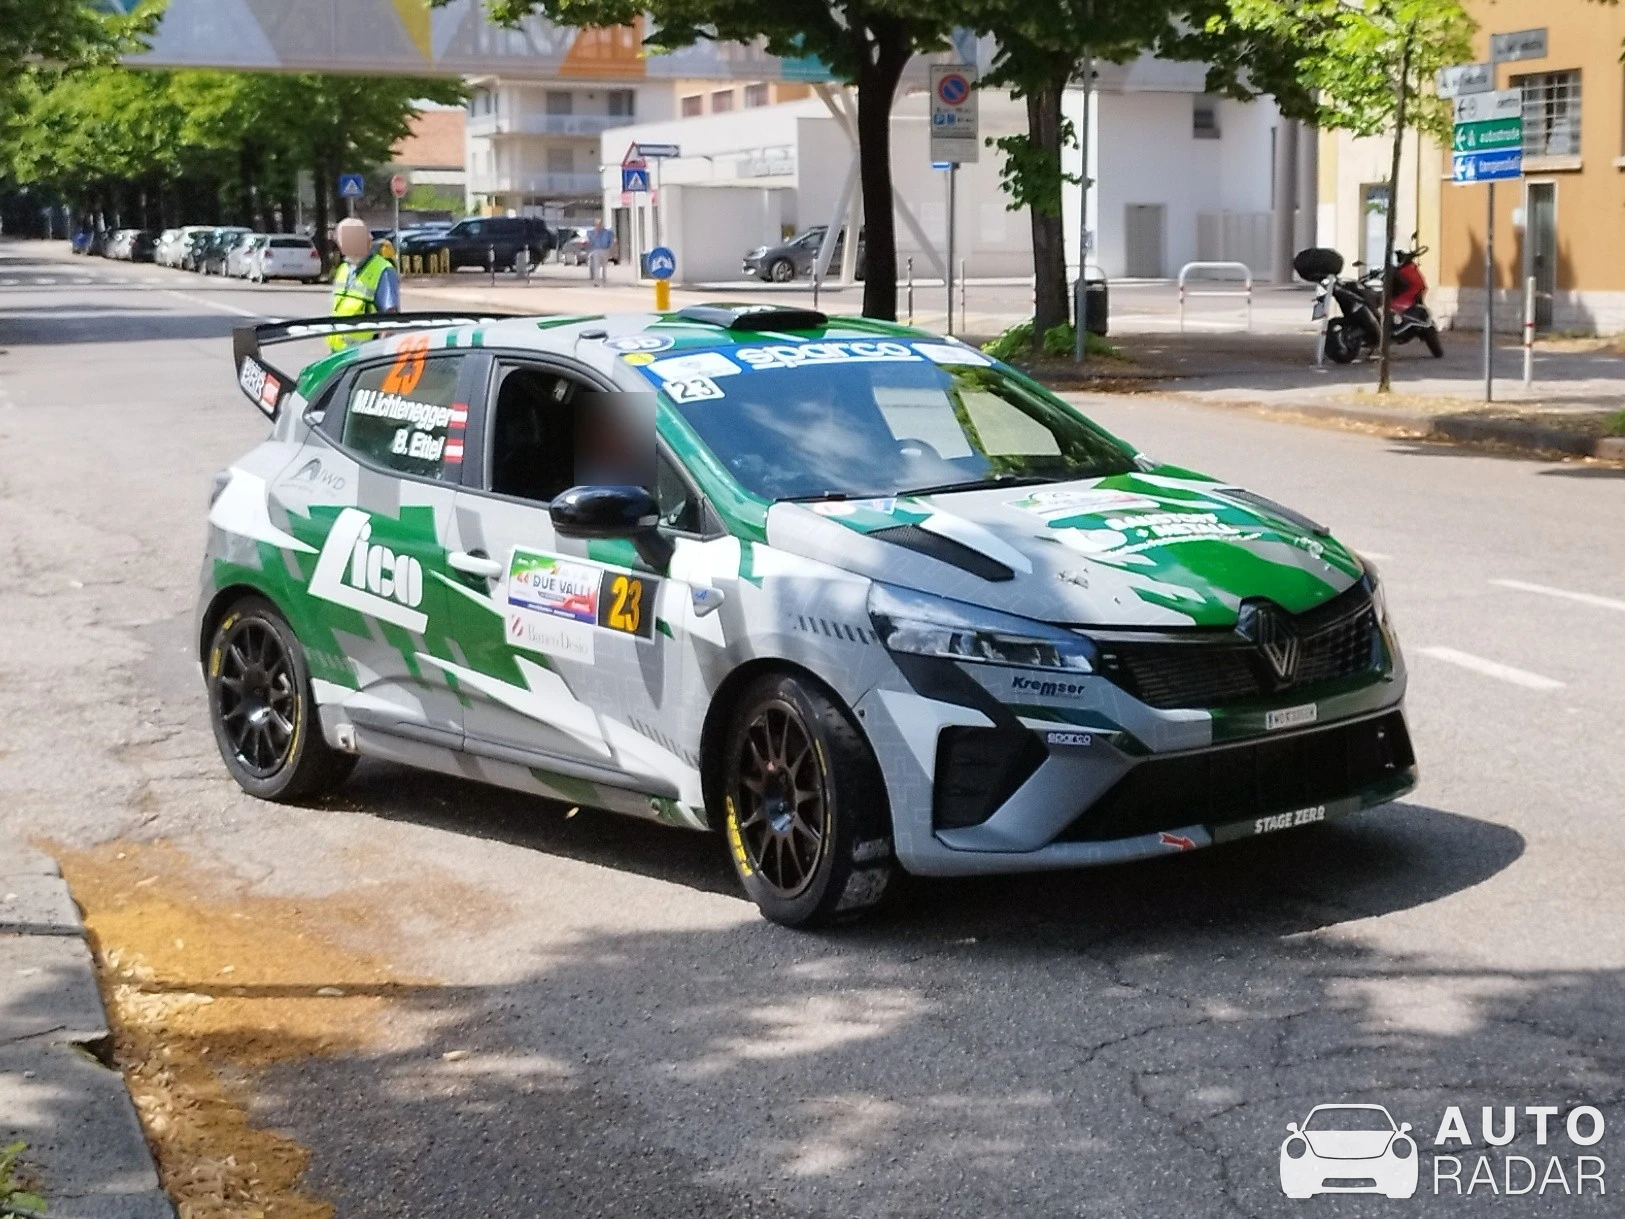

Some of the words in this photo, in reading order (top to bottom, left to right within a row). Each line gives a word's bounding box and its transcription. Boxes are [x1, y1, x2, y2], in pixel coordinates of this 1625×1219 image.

[381, 335, 430, 396] 23
[736, 341, 913, 369] sparco
[670, 378, 716, 399] 23
[532, 574, 558, 592] DUE
[559, 581, 592, 598] VALLI
[609, 575, 643, 633] 23
[1012, 676, 1086, 696] Kremser
[1046, 732, 1092, 746] sparco
[1254, 812, 1293, 834] STAGE
